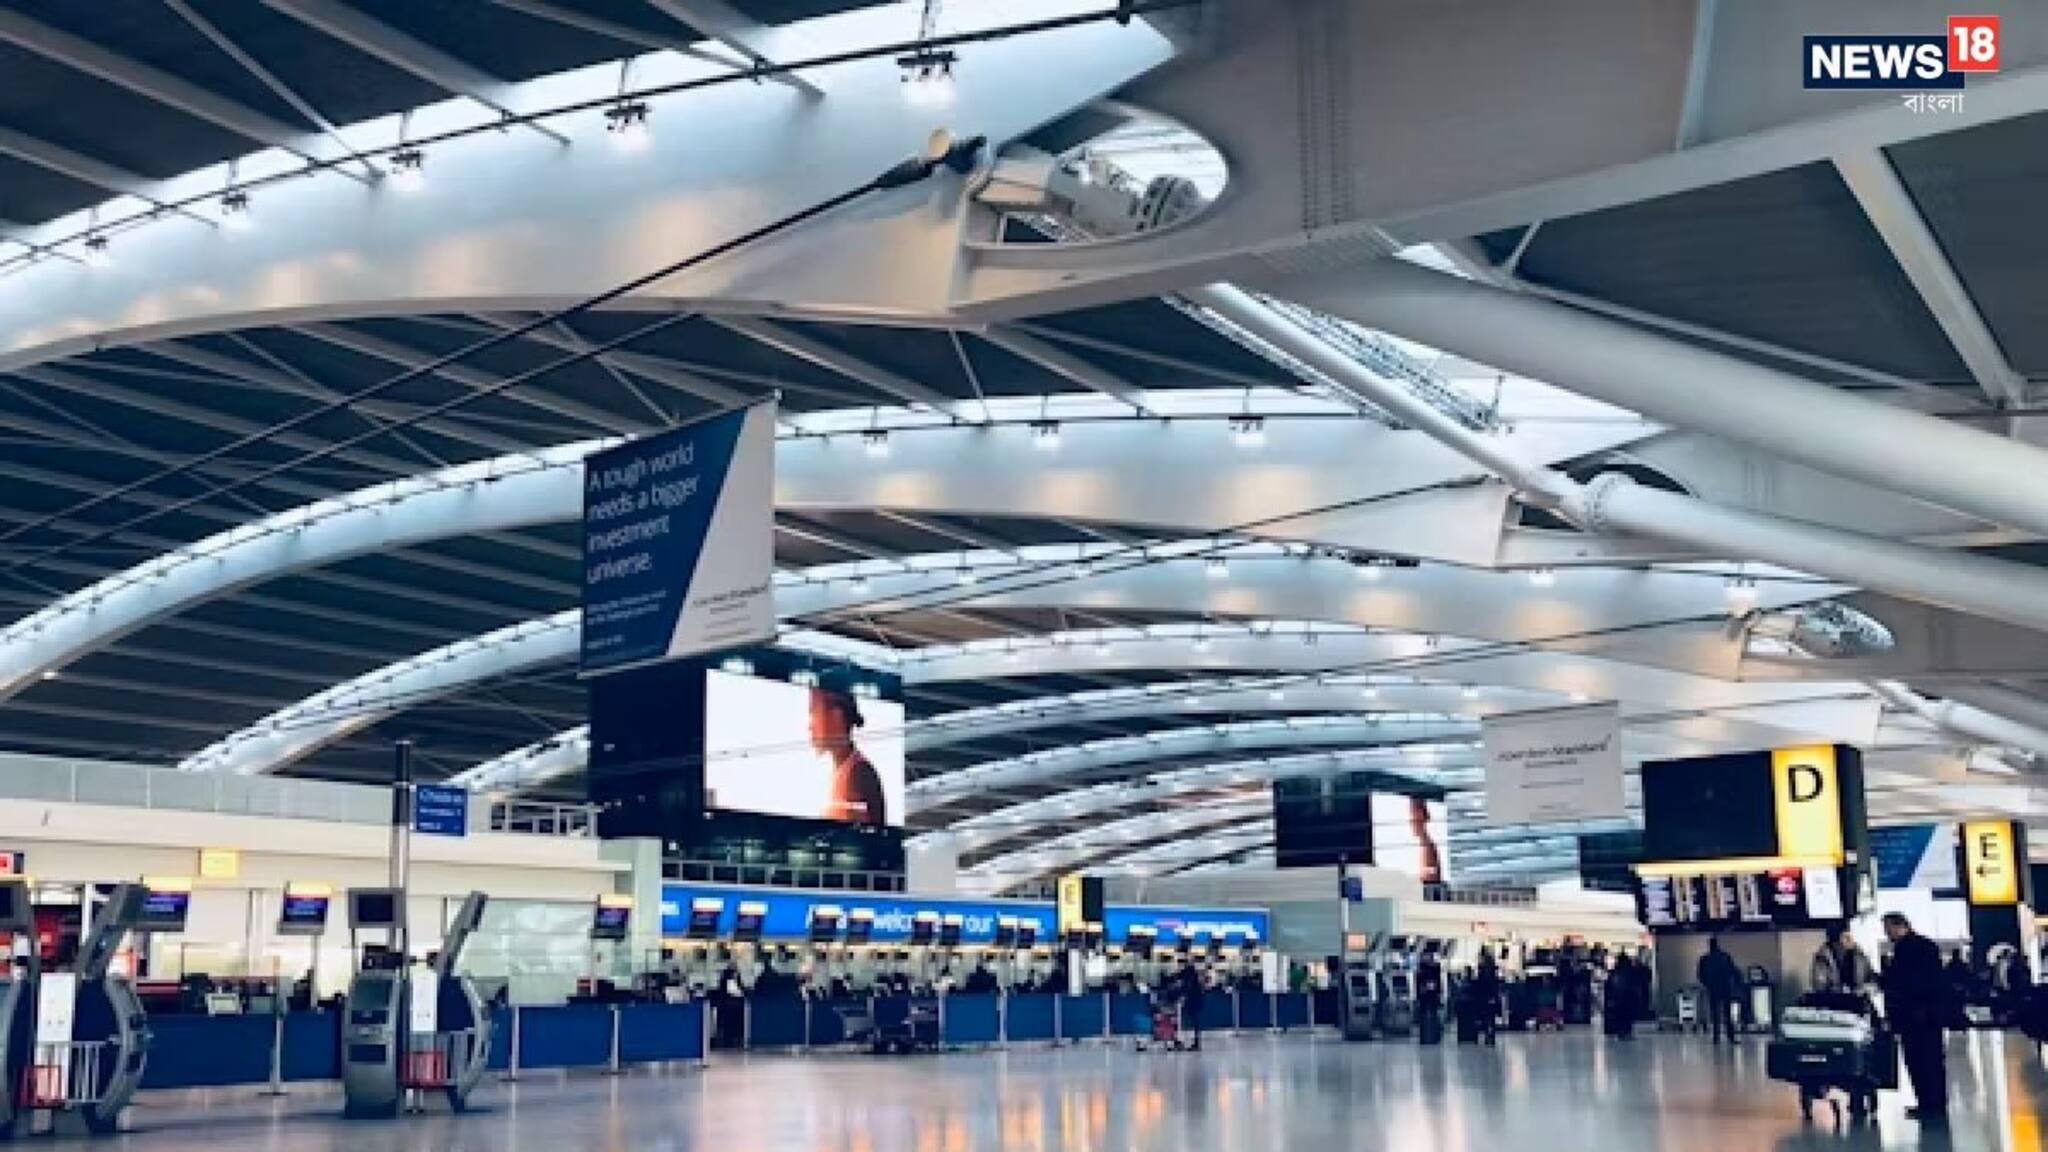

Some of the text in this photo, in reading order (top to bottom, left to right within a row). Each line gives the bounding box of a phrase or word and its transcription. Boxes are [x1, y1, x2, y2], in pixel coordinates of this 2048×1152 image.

[589, 441, 694, 491] A tough world
[588, 475, 700, 520] needs a bigger
[587, 514, 670, 552] investment
[1788, 764, 1823, 802] D
[1979, 832, 1998, 860] E
